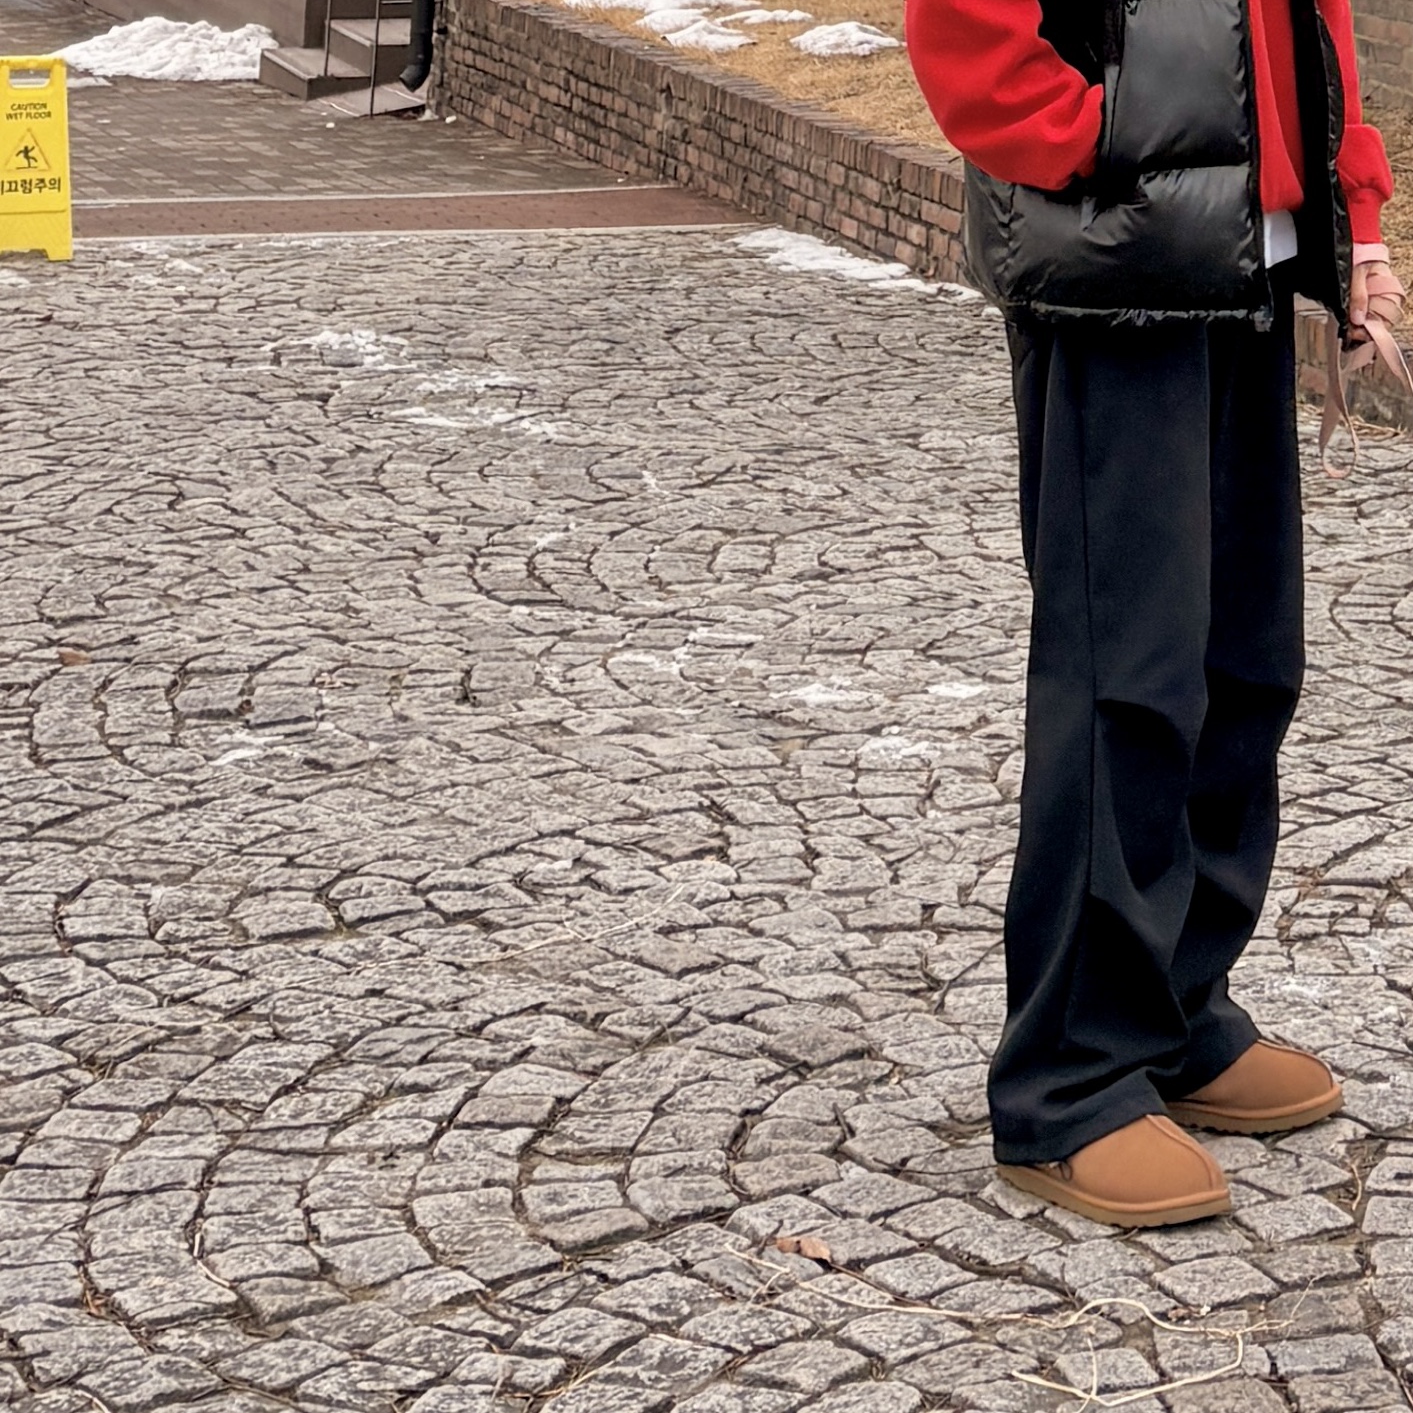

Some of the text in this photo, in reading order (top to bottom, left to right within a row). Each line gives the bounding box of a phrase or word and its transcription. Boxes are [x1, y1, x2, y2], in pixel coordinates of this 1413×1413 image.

[10, 102, 47, 111] CAUTION
[5, 110, 52, 120] WET FLOOR
